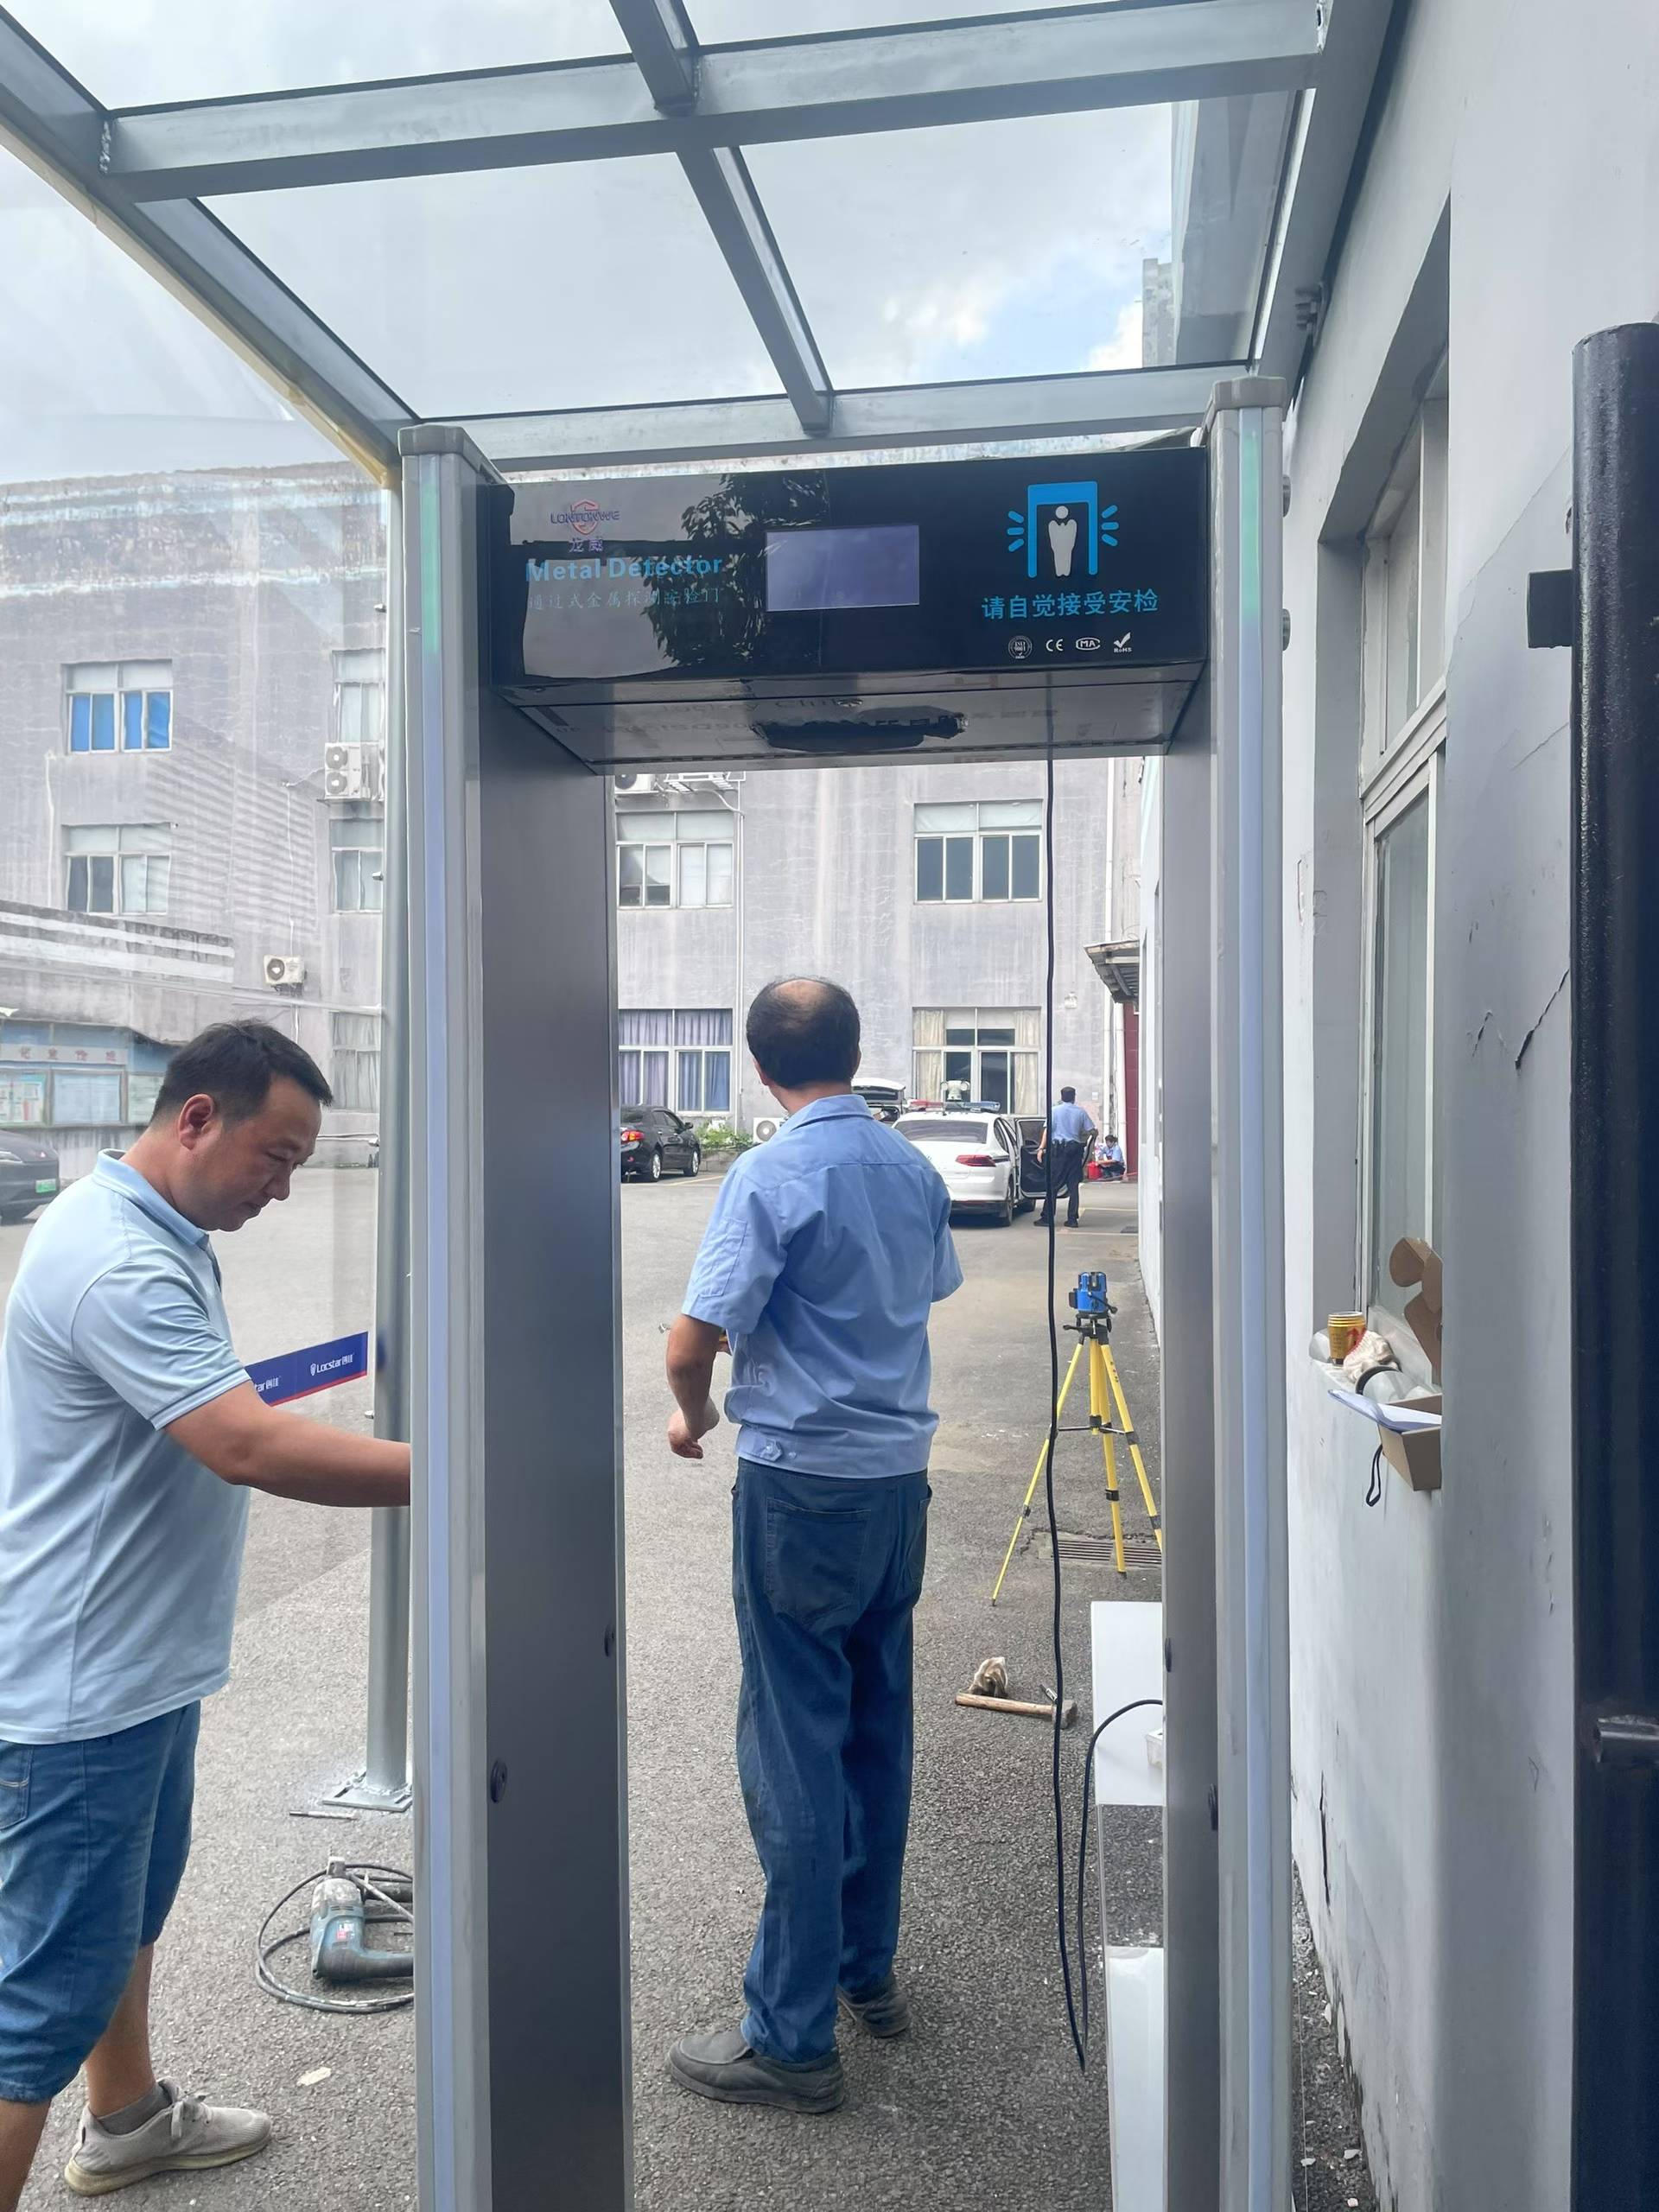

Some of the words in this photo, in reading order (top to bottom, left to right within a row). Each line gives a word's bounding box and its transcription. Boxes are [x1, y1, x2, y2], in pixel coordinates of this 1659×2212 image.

[526, 558, 602, 582] Metal
[609, 554, 724, 579] Detector
[981, 588, 1159, 620] 请自觉接受安检
[1046, 639, 1063, 652] CE
[317, 1358, 341, 1373] Locstar
